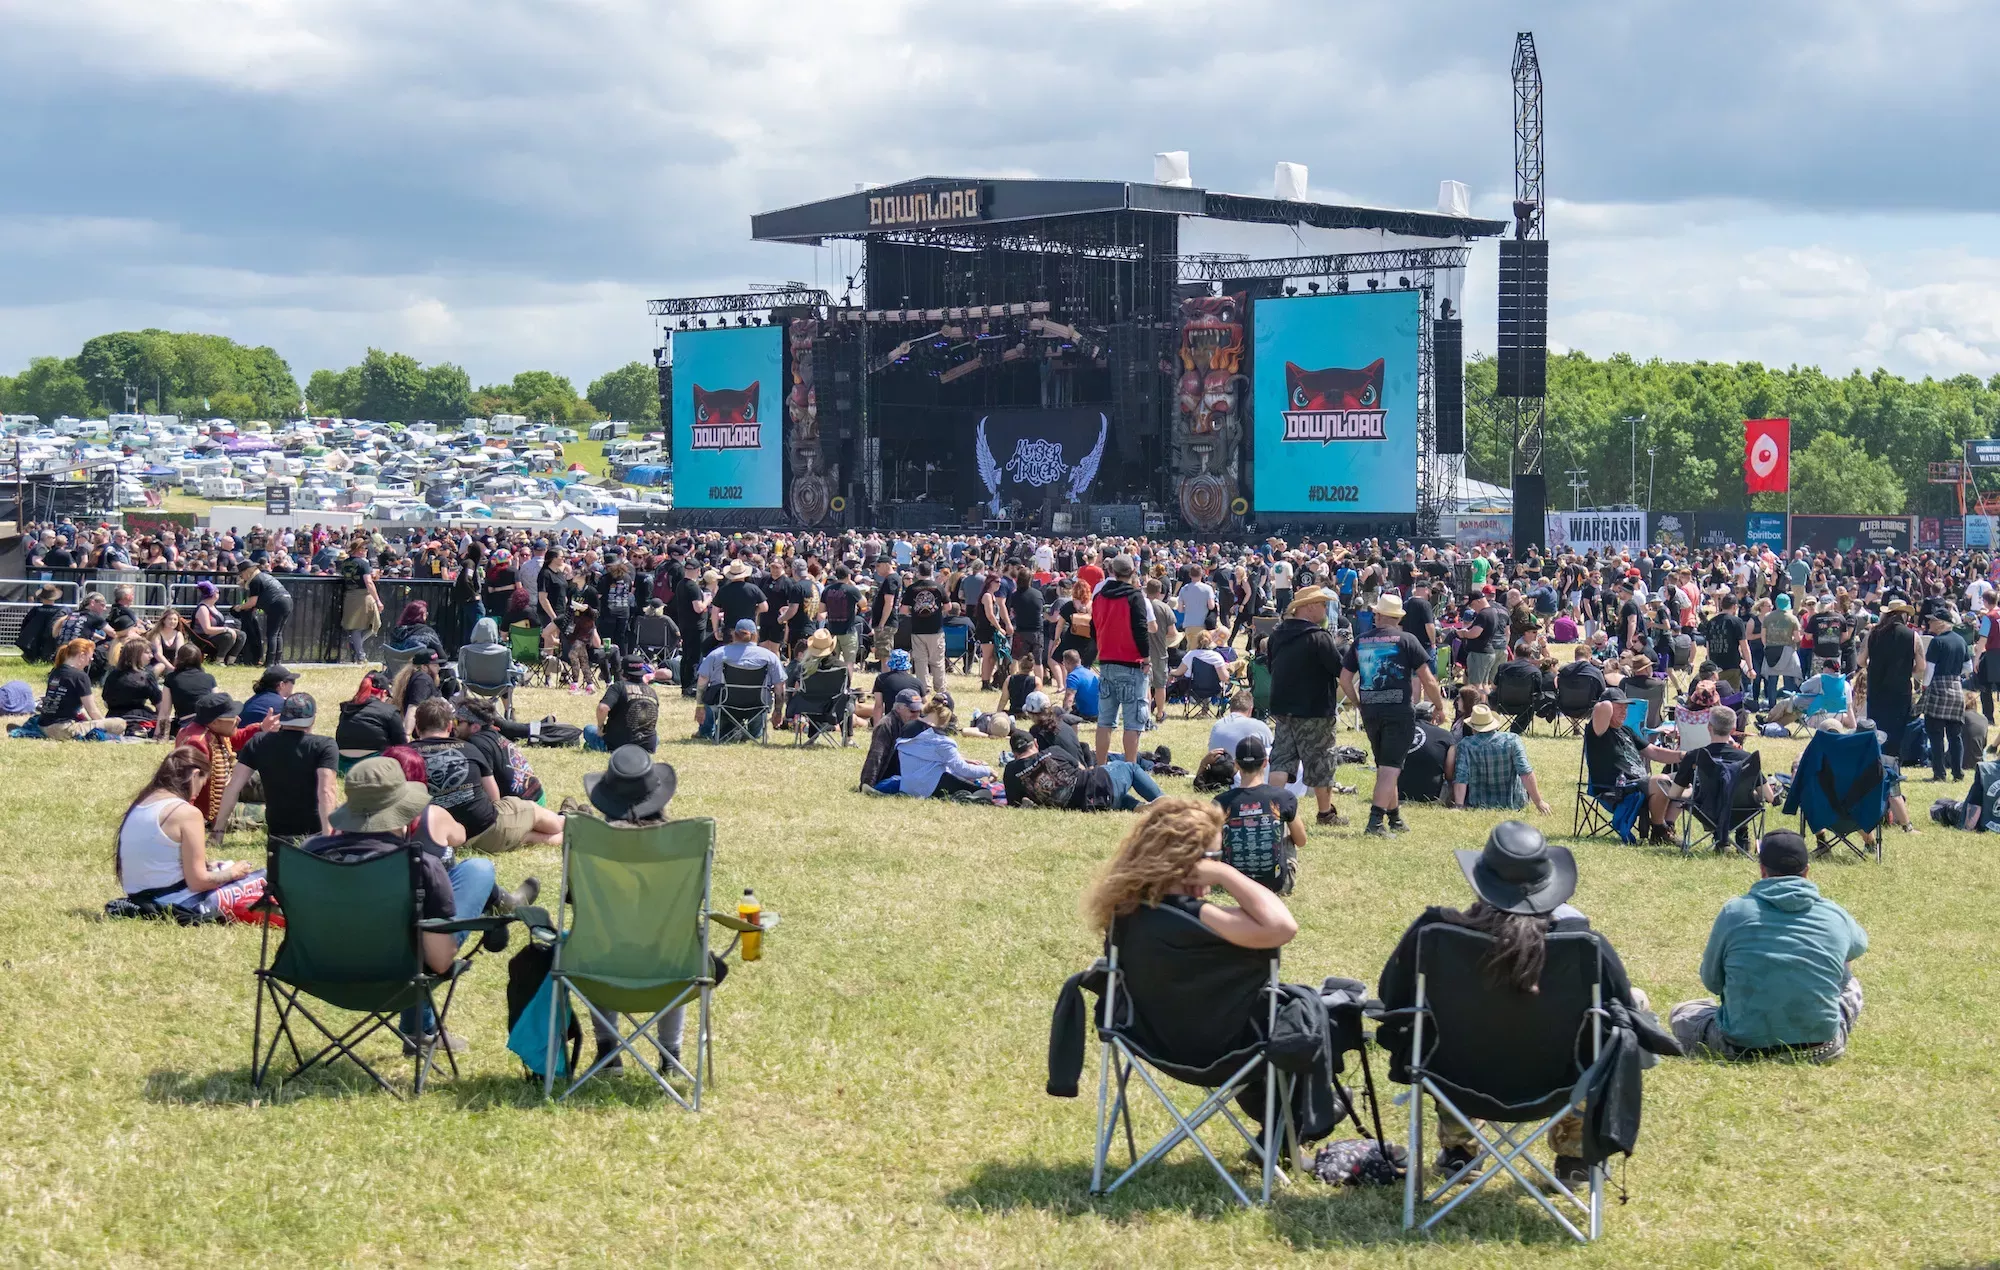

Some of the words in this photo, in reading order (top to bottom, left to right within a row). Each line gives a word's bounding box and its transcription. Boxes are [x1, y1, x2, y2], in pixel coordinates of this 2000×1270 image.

[869, 189, 978, 225] DOWNLOAD
[1287, 413, 1383, 439] DOWNLOAD
[694, 426, 760, 448] DOWNLOAD
[709, 486, 743, 499] #DL2022
[1309, 485, 1359, 502] #DL2022
[1474, 520, 1498, 530] MAIDEN
[1569, 517, 1641, 542] WARGASM
[1859, 520, 1880, 532] ALTER
[1881, 520, 1907, 533] BRIDGE
[1747, 530, 1782, 541] Spiritbox
